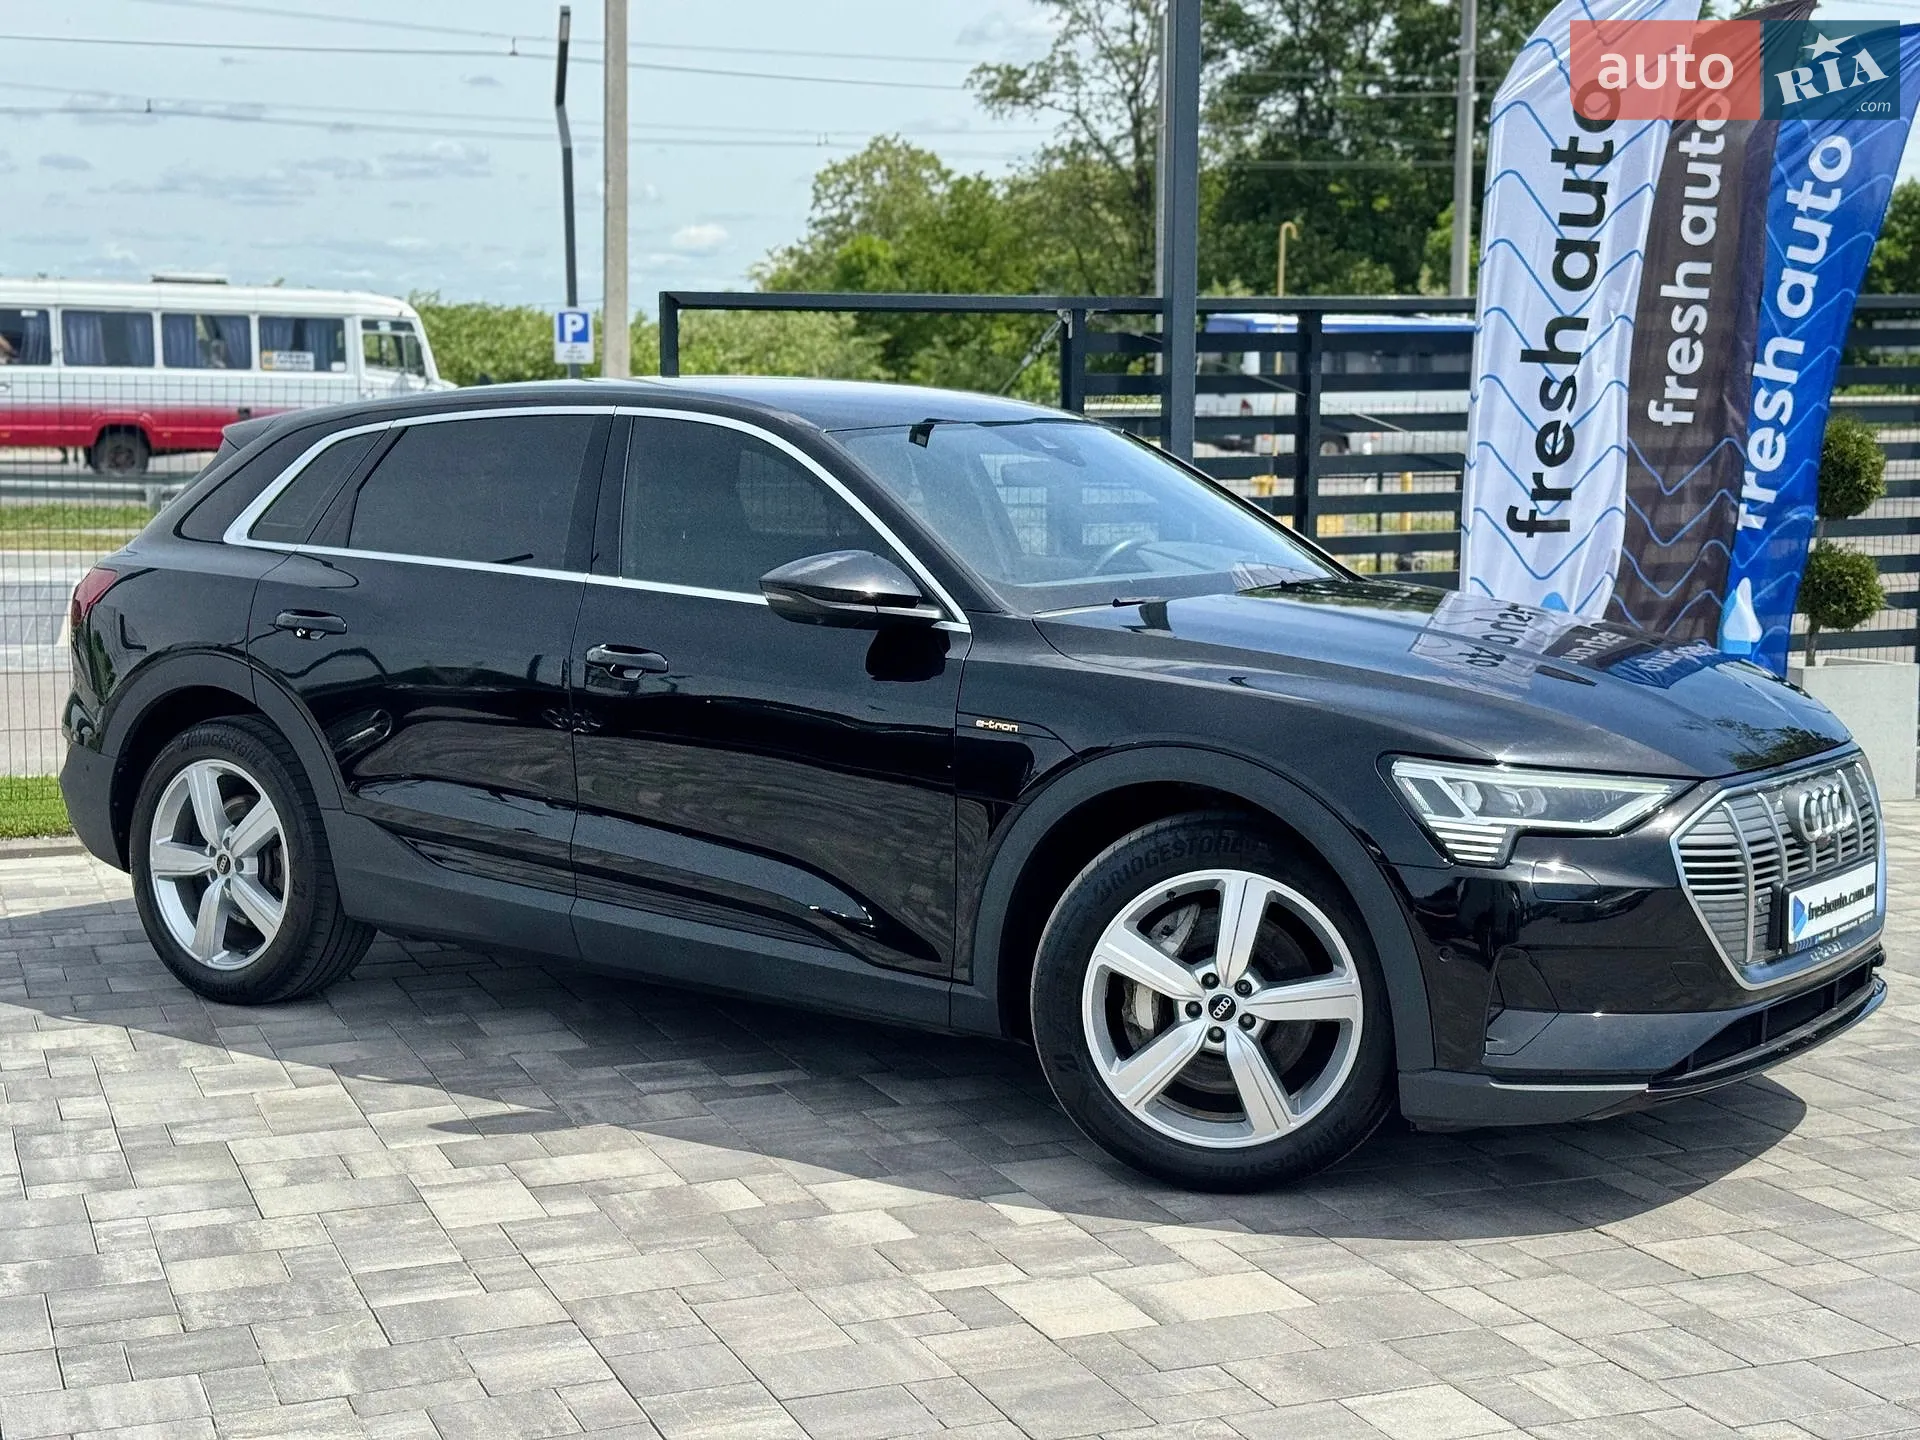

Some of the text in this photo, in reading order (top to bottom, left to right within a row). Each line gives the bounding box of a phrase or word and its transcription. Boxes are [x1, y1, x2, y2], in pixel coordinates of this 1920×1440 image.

[1506, 78, 1621, 538] fresh auto
[1648, 93, 1732, 427] fresh auto
[1776, 135, 1853, 319] auto
[564, 313, 585, 342] P
[975, 719, 1019, 732] e-tron
